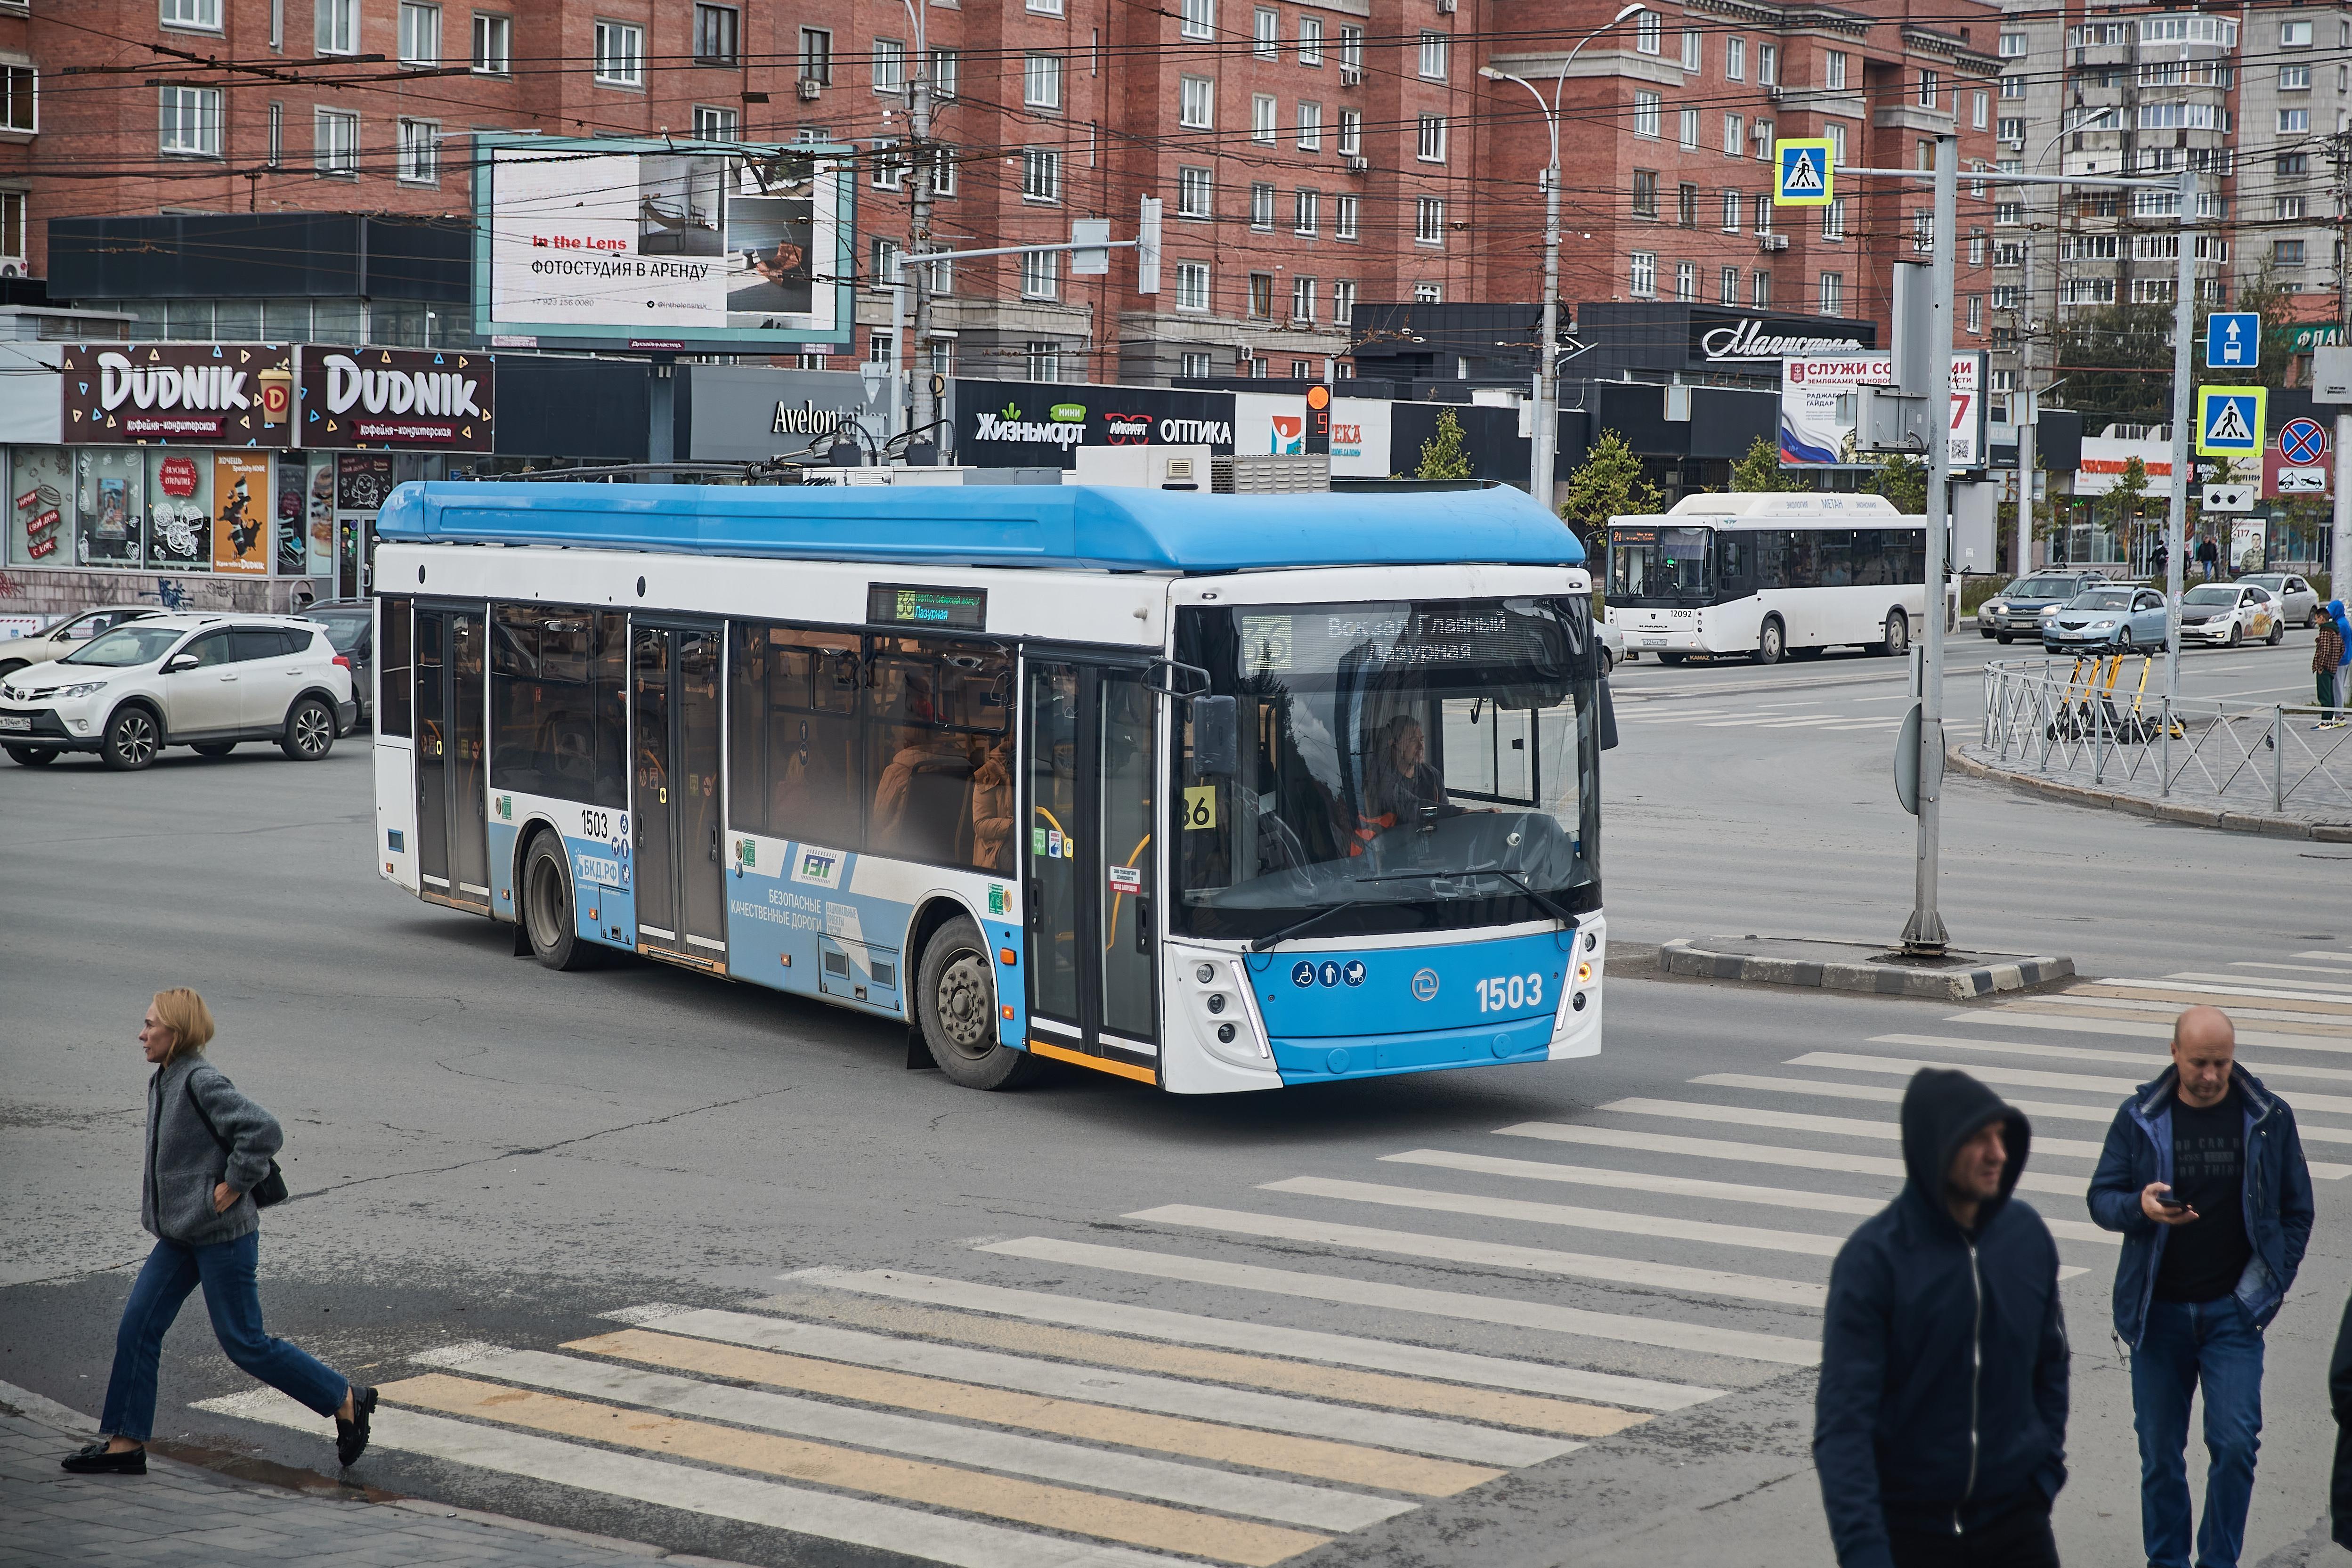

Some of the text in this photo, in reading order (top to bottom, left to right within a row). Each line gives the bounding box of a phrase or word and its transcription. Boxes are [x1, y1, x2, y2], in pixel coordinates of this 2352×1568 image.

[532, 236, 627, 250] In the Lens
[532, 260, 708, 280] ФОТОСТУДИЯ В АРЕНДУ
[1808, 363, 1866, 375] СЛУЖИ
[97, 352, 251, 411] DUDNIK
[323, 354, 480, 417] DUDNIK
[1059, 408, 1080, 418] МИНИ
[1318, 413, 1328, 434] 9
[127, 419, 216, 433] Кофейня-кондитерская
[360, 423, 451, 438] Кофейня-кондитерская
[975, 413, 1086, 451] Жизньмарт
[1109, 421, 1148, 436] АЙКРАФТ
[1160, 419, 1232, 445] ОПТИКА
[1821, 499, 1843, 509] МЕТАН
[897, 593, 914, 616] 36
[915, 606, 949, 621] Лазурная
[1328, 611, 1507, 638] Вокзал Главный
[1366, 642, 1471, 664] Лазурная
[582, 809, 608, 838] 1503
[806, 848, 837, 859] НОВОСИБИРСК
[584, 859, 617, 882] БКД.РФ
[769, 889, 821, 914] БЕЗОПАСНЫЕ
[827, 903, 857, 919] НАЦИОНАЛЬНЫЕ
[731, 899, 822, 932] КАЧЕСТВЕННЫЕ ДОРОГИ
[1476, 974, 1542, 1012] 1503
[2198, 1138, 2224, 1149] CAN
